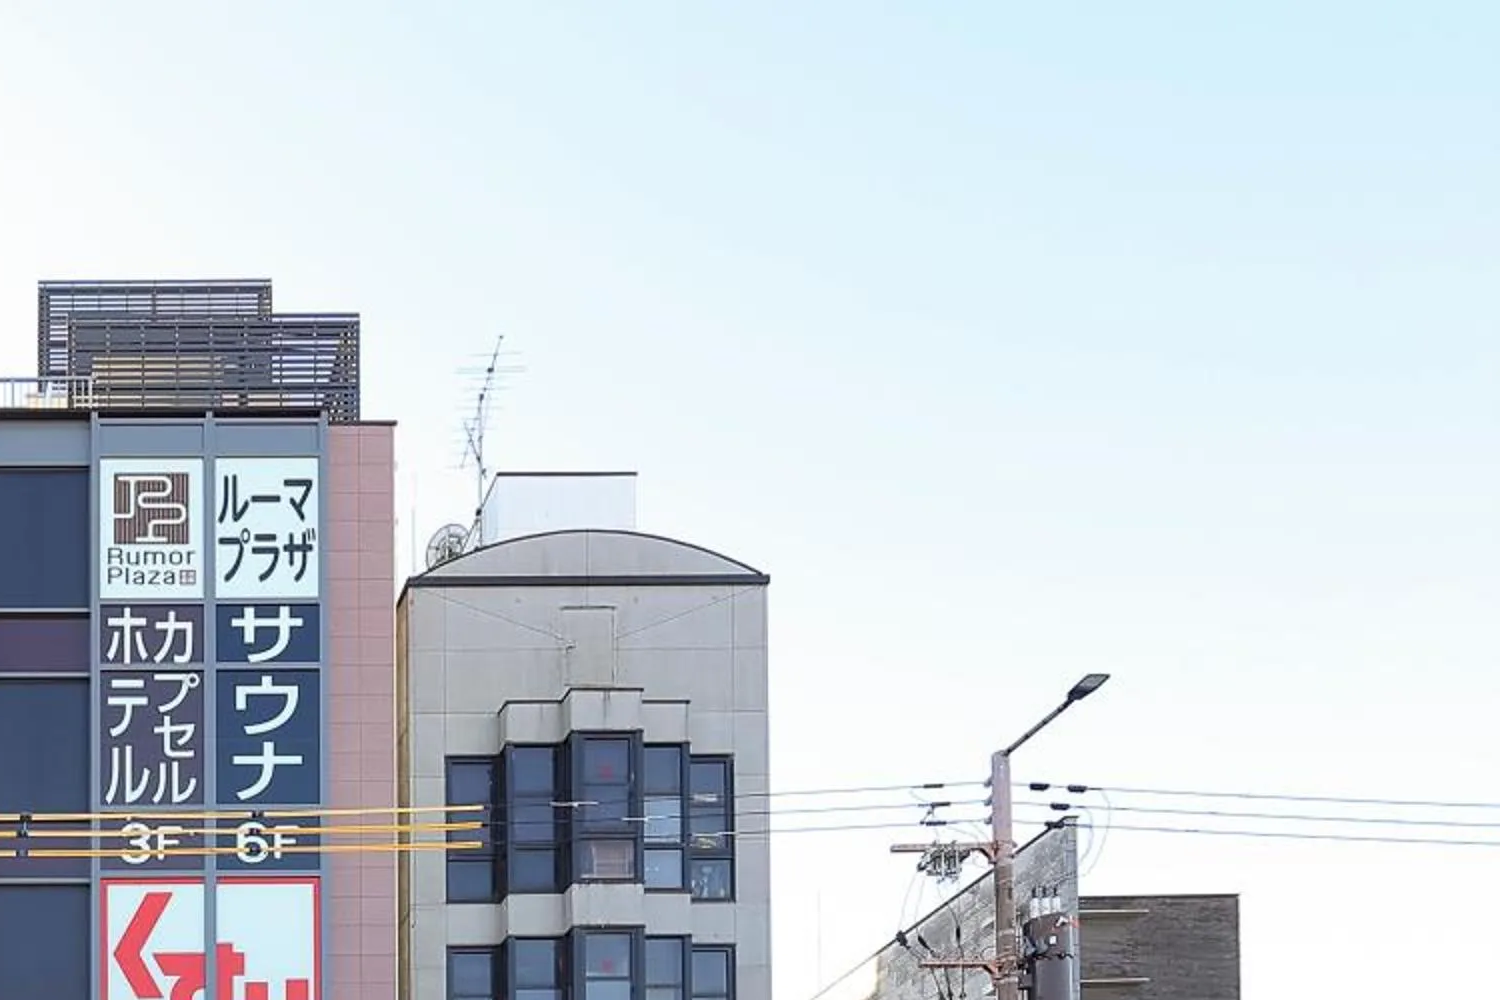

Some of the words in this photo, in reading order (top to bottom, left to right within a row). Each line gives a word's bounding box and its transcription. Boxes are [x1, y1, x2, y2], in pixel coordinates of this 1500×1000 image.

[217, 474, 313, 523] ルーマ
[107, 547, 195, 566] Rumor
[107, 567, 175, 585] Plaza
[218, 528, 316, 582] プラザ
[106, 607, 151, 804] ホテル
[152, 611, 199, 803] カプセル
[231, 606, 304, 801] サウナ
[120, 822, 183, 864] 3F
[236, 822, 298, 864] 6F
